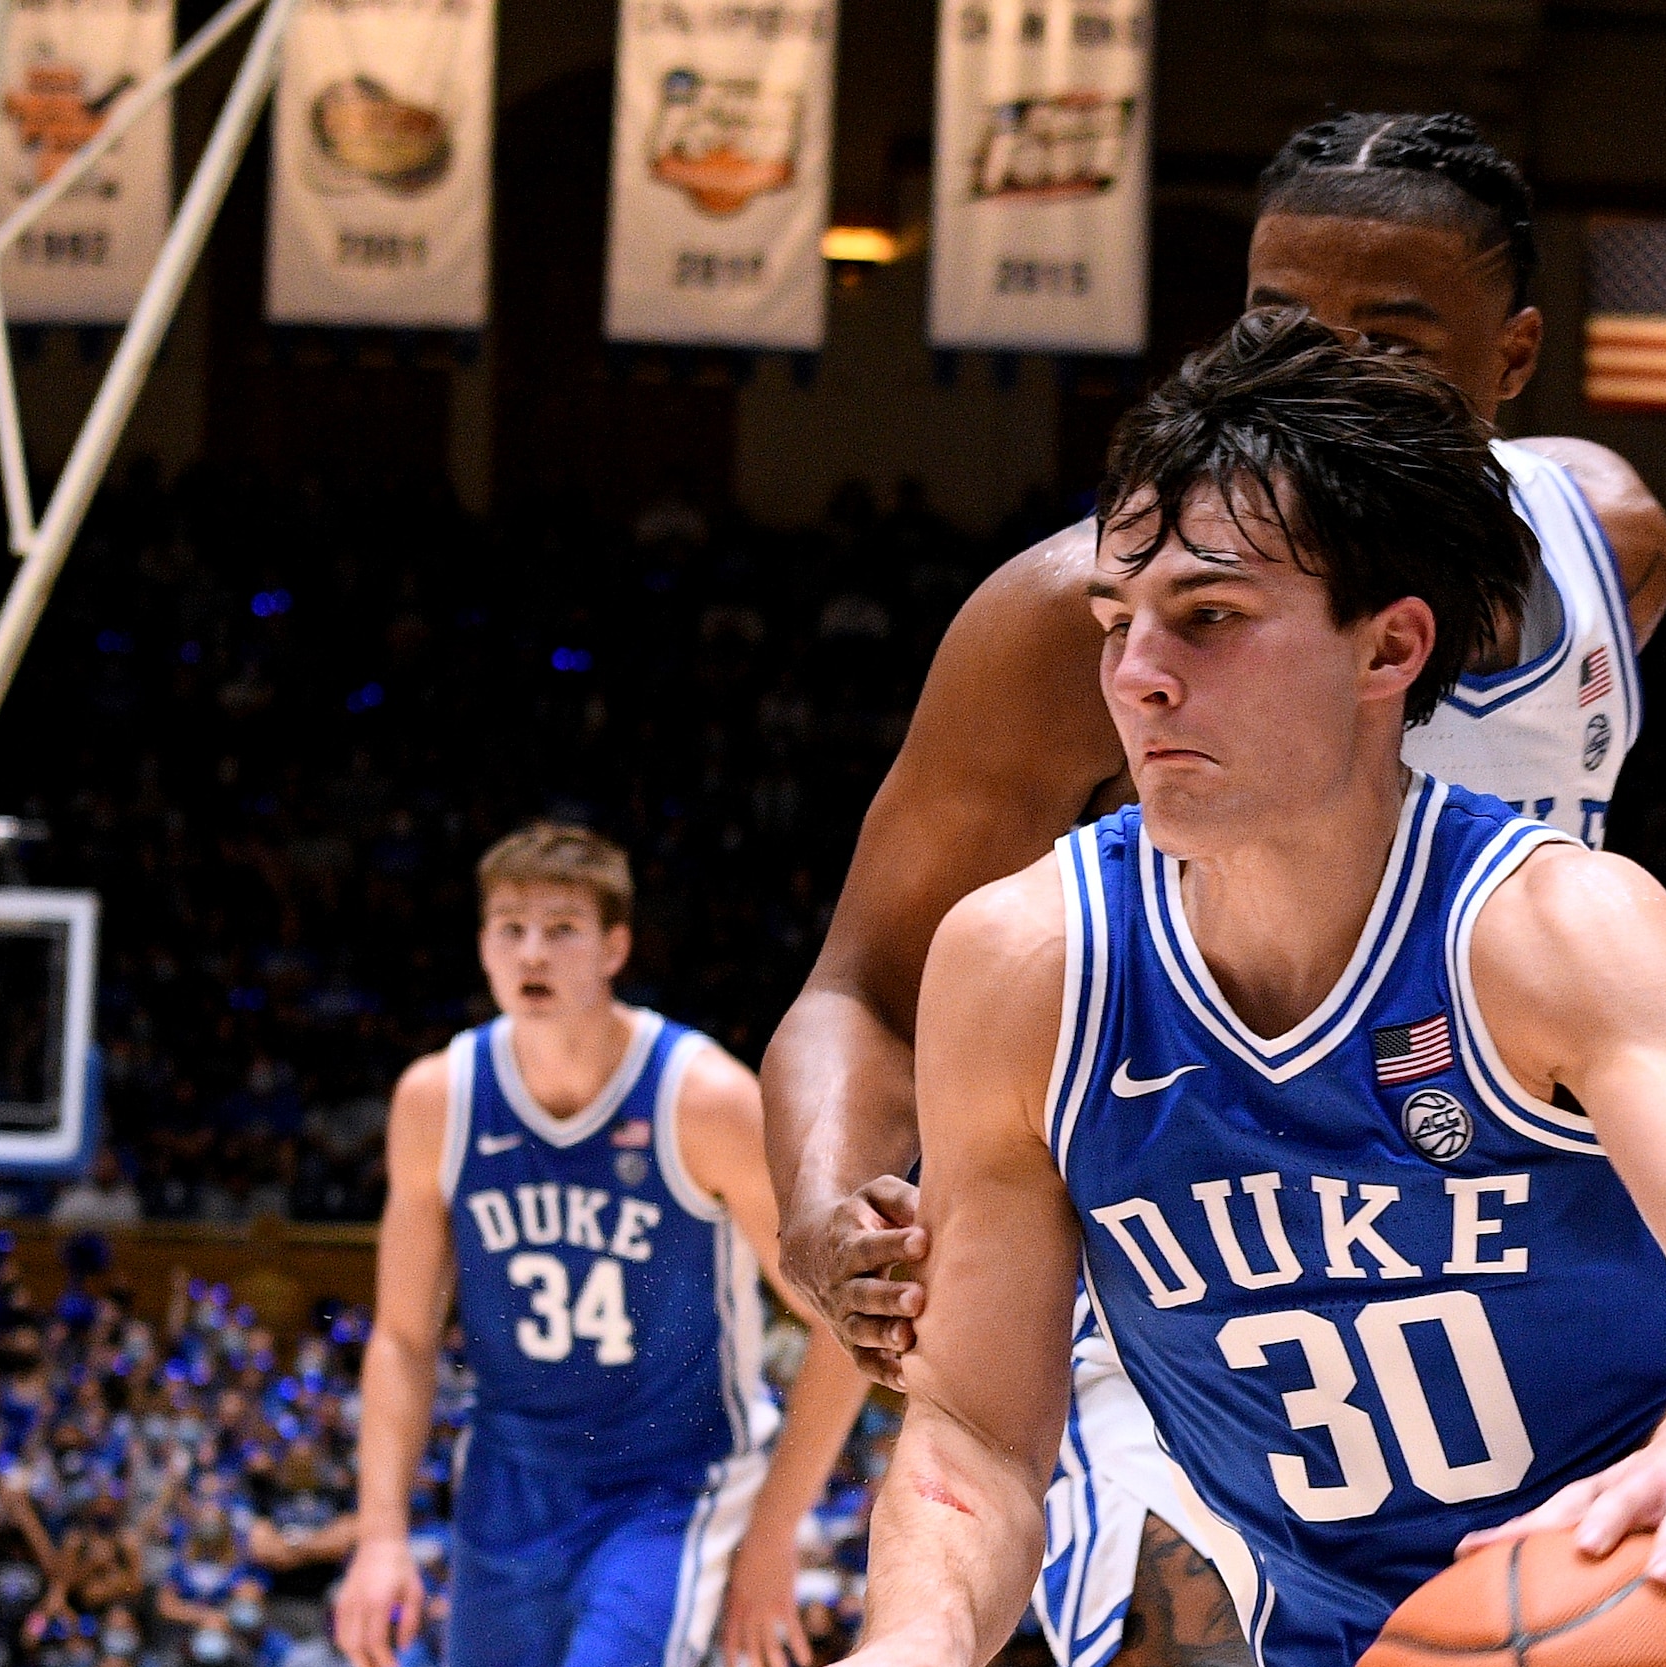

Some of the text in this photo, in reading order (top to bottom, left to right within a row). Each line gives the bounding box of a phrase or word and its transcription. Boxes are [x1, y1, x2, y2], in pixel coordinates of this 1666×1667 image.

[467, 1181, 662, 1263] DUKE
[1090, 1172, 1531, 1309] DUKE
[507, 1253, 636, 1366] 34
[1215, 1290, 1536, 1522] 30
